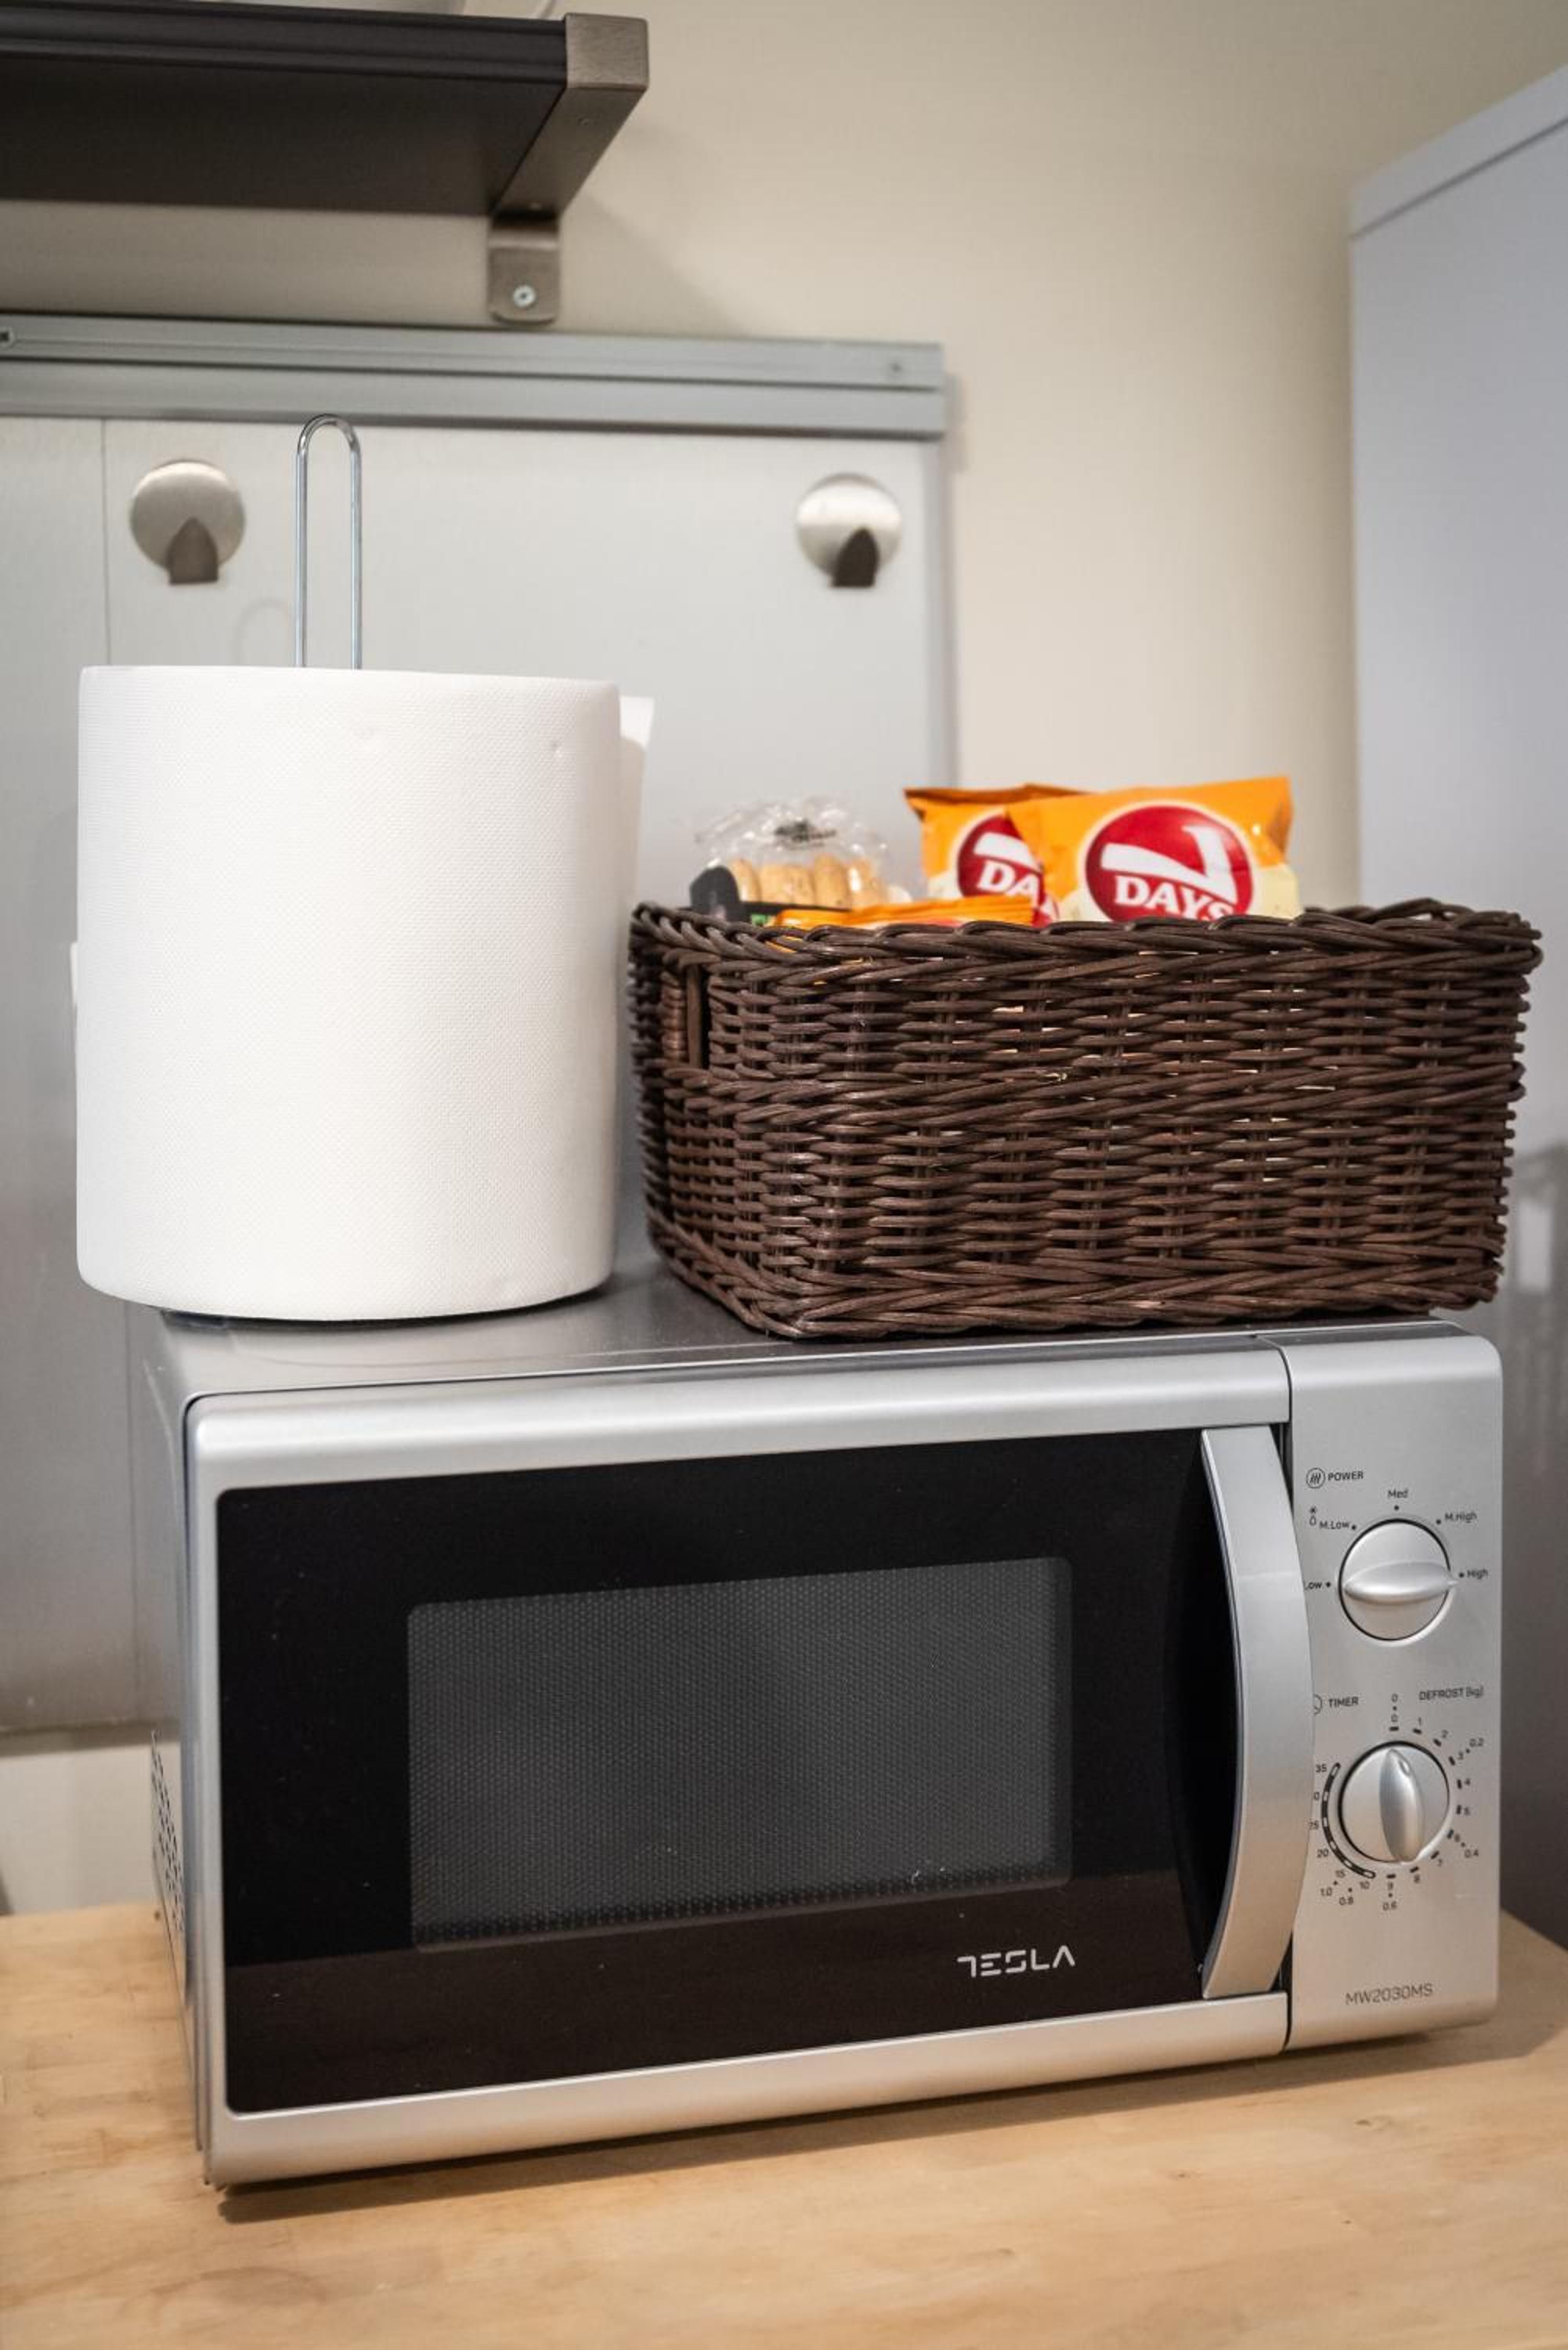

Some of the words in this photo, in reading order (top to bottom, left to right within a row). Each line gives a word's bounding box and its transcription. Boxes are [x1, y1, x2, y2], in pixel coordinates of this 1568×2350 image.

[1101, 825, 1237, 905] 7
[977, 860, 1040, 907] DA
[1328, 1471, 1364, 1481] POWER
[1387, 1489, 1408, 1499] Med
[1444, 1513, 1478, 1523] M.High
[1319, 1520, 1349, 1530] M.Low
[1467, 1570, 1488, 1579] High
[1391, 1694, 1398, 1702] 0
[1418, 1687, 1465, 1701] DEFROST
[1328, 1696, 1359, 1708] TIMER
[1315, 1764, 1328, 1773] 35
[1317, 1849, 1329, 1858] 20
[956, 1945, 1076, 1978] TESLA
[1345, 1983, 1433, 2005] MW2030MS
